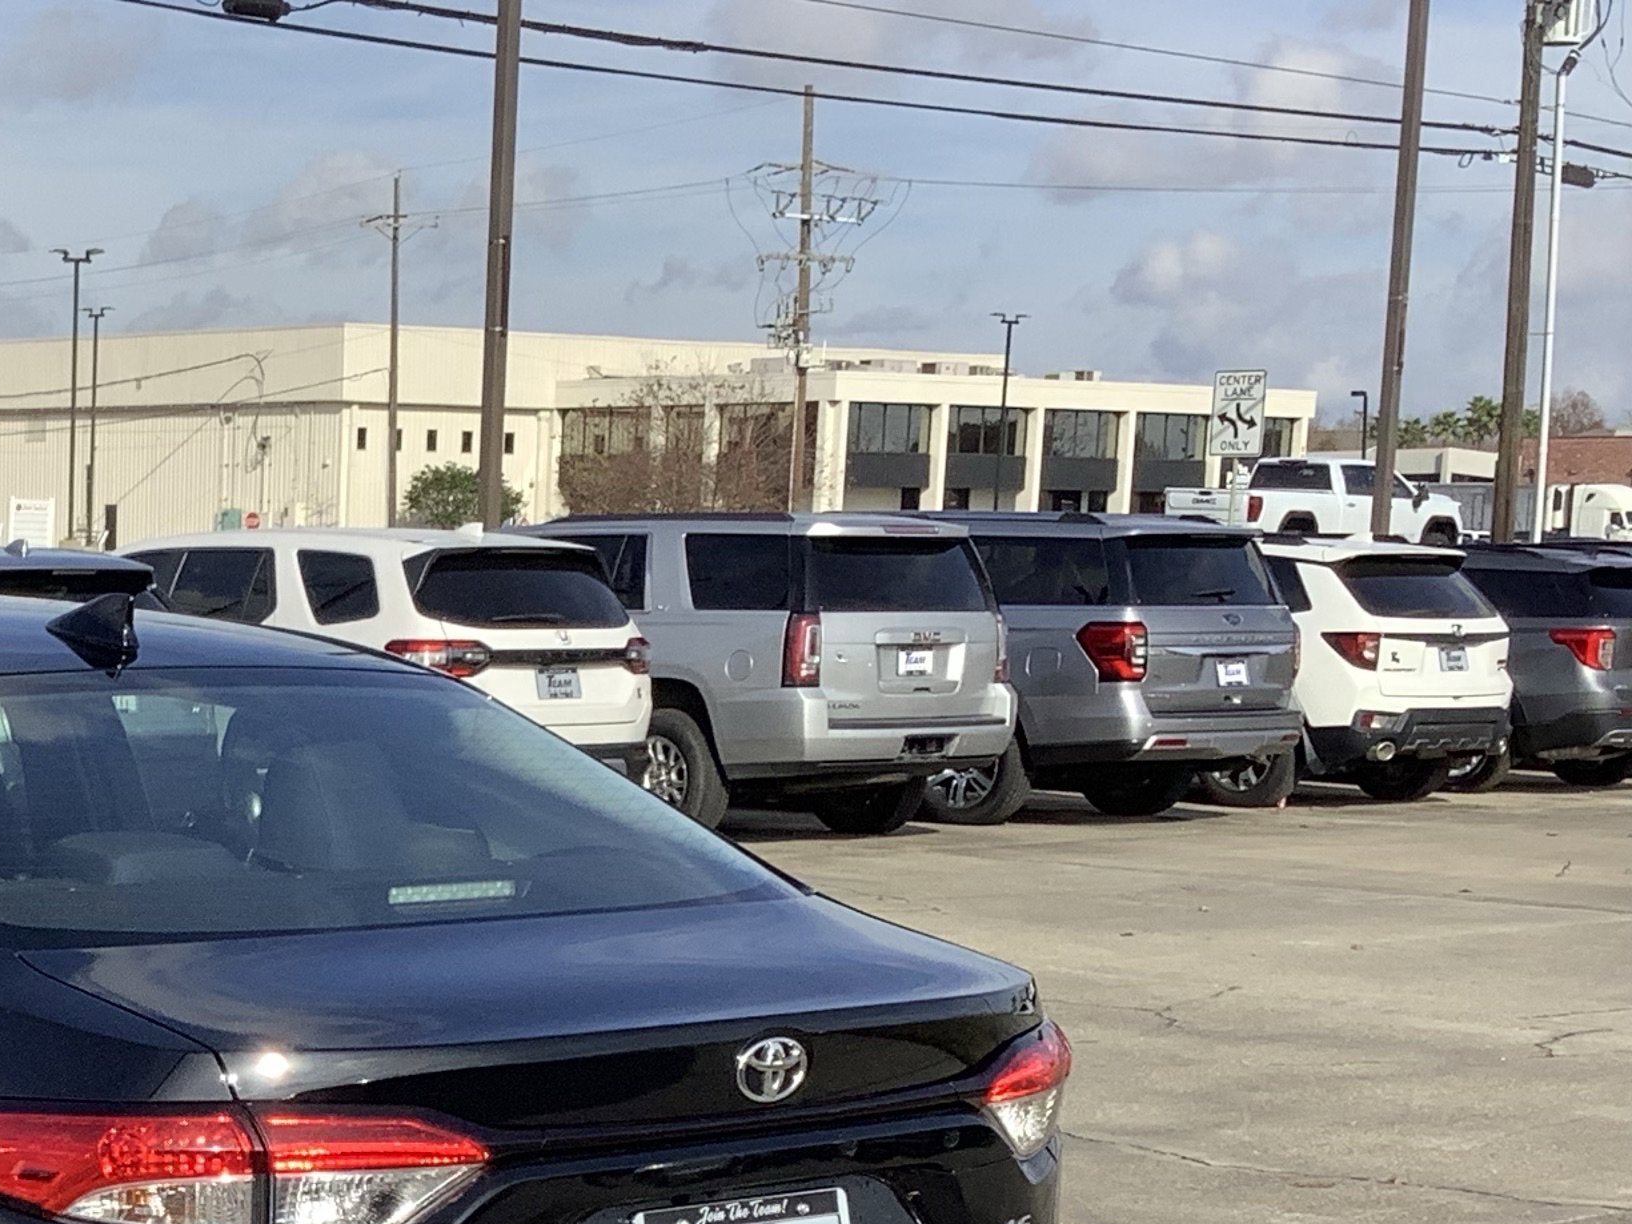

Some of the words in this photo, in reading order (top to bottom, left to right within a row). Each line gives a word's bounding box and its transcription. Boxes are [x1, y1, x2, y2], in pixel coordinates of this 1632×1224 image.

[1218, 375, 1263, 386] CENTER
[1224, 385, 1255, 397] LANE
[1219, 440, 1250, 451] ONLY
[546, 674, 573, 689] TEAM
[749, 1198, 789, 1219] Team!
